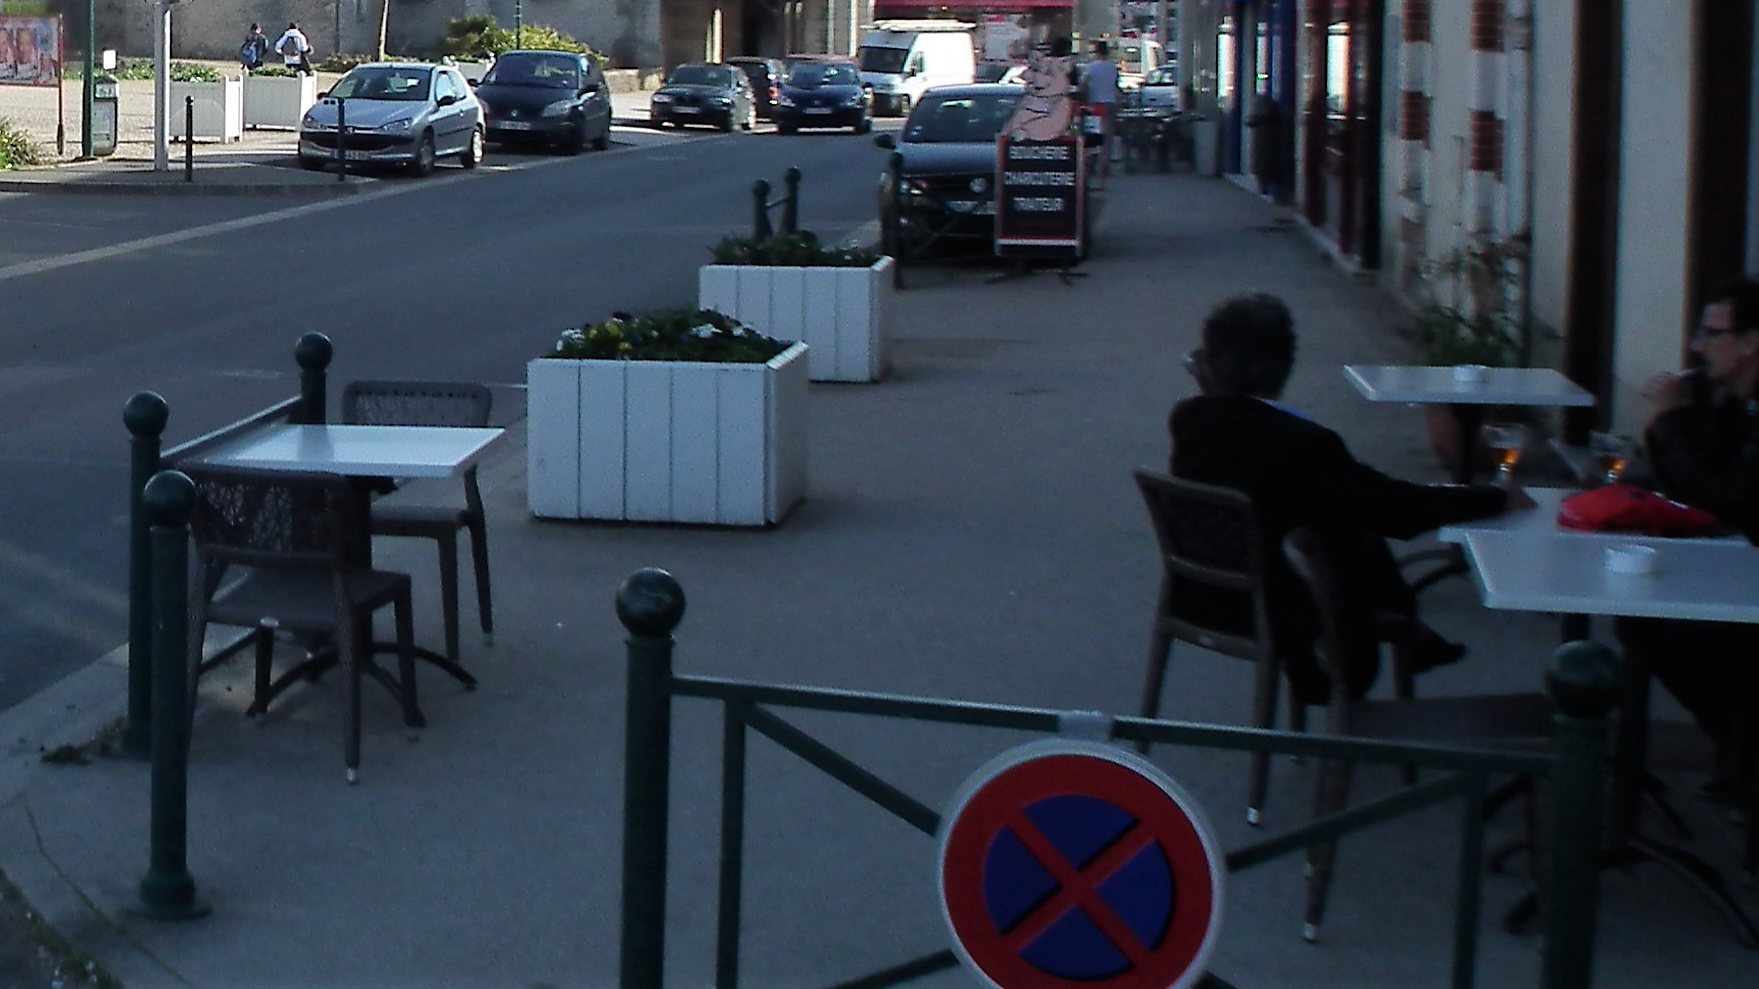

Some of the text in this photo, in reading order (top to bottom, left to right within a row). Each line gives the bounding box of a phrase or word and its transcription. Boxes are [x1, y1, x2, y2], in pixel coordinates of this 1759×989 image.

[1009, 145, 1069, 160] BOUCHERIE
[1004, 171, 1076, 186] CHARCUTERIE
[1013, 196, 1064, 211] TRAITEUR
